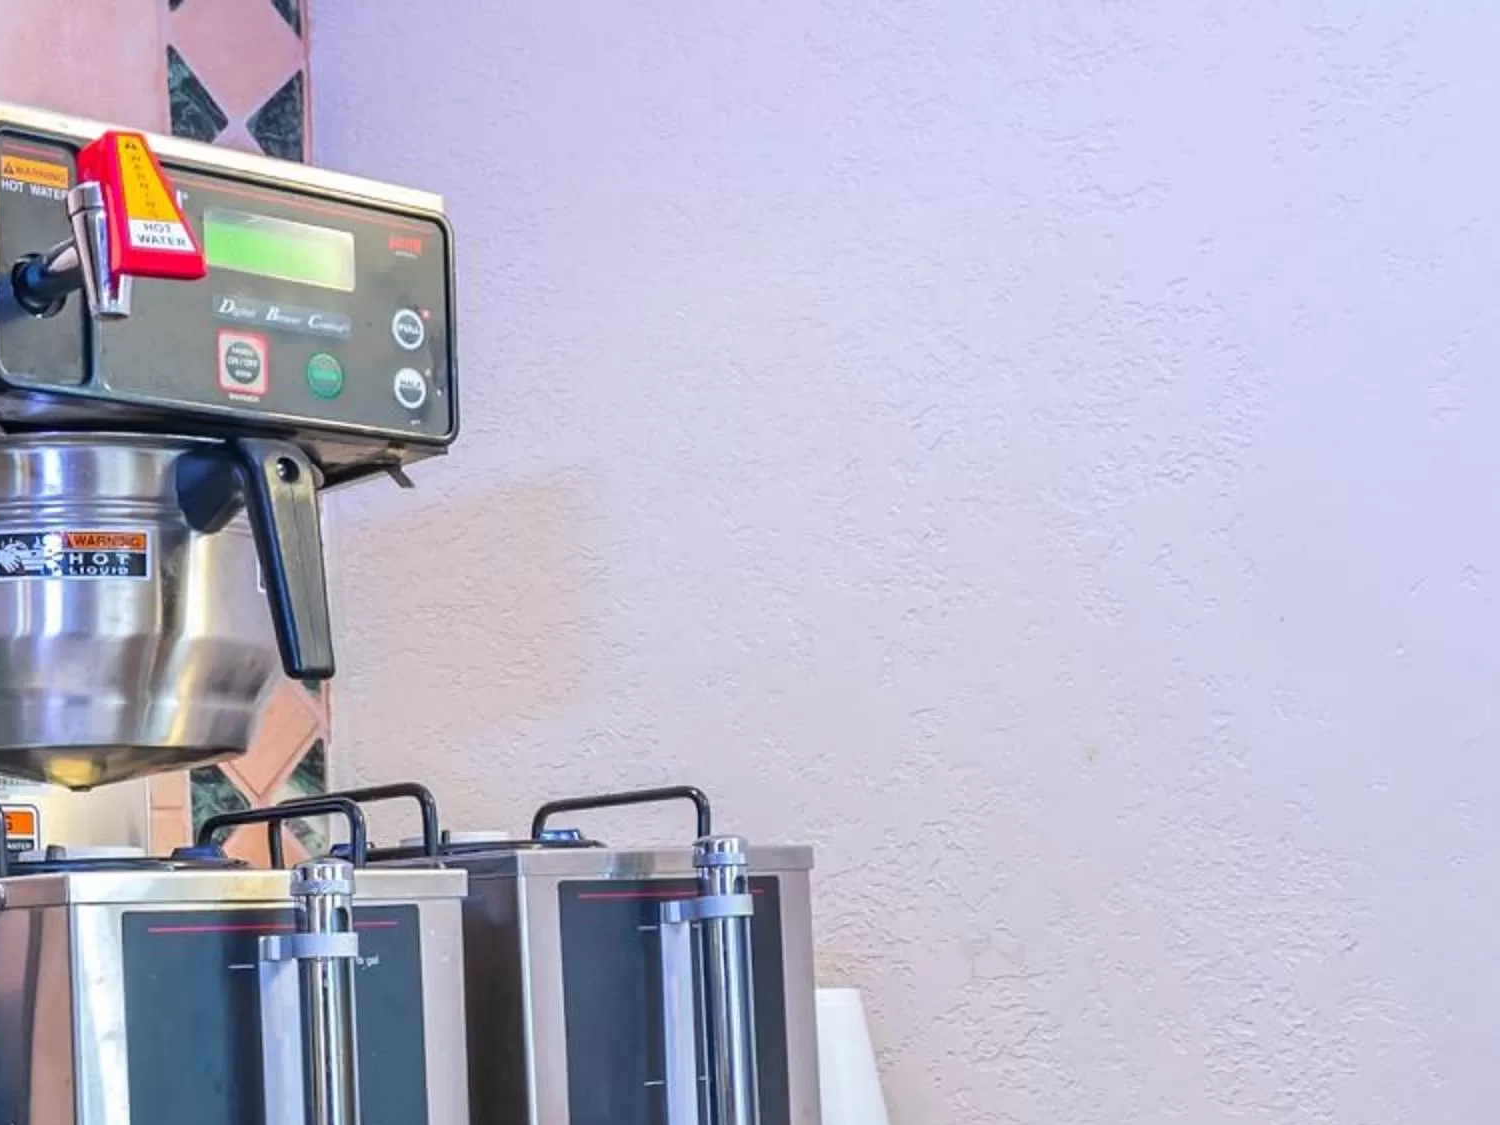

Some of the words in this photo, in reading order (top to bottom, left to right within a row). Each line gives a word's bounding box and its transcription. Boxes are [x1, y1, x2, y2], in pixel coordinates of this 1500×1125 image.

[2, 180, 24, 193] HOT
[143, 222, 171, 232] HOT
[136, 234, 187, 247] WATER
[75, 535, 142, 548] WARNING
[70, 554, 131, 564] HOT
[70, 565, 129, 575] LIQUID
